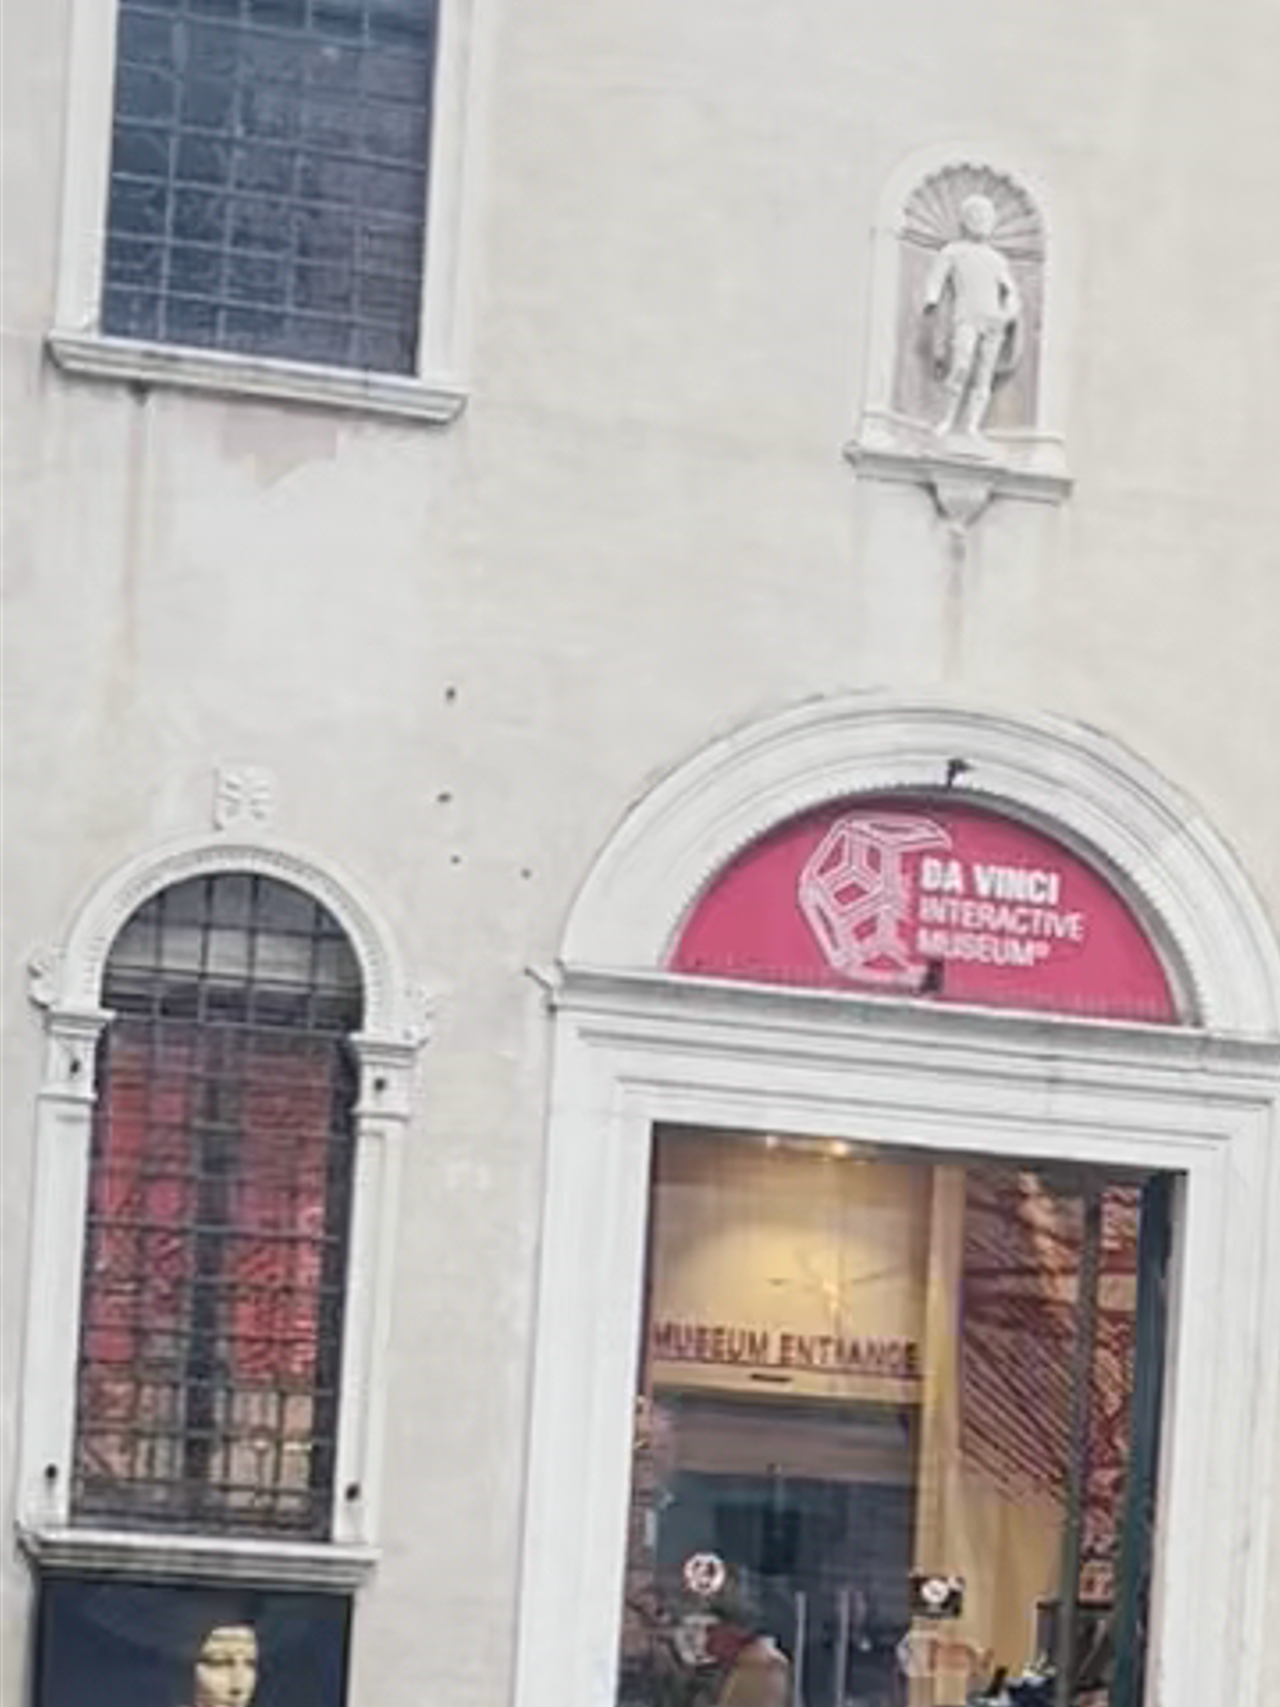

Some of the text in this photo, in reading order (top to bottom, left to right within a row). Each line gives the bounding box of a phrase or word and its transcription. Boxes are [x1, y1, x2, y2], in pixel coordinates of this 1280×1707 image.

[921, 856, 1060, 906] DA VINCI
[918, 895, 1085, 942] INTERACTIVE
[652, 1322, 919, 1375] MUSEUM ENTRANCE
